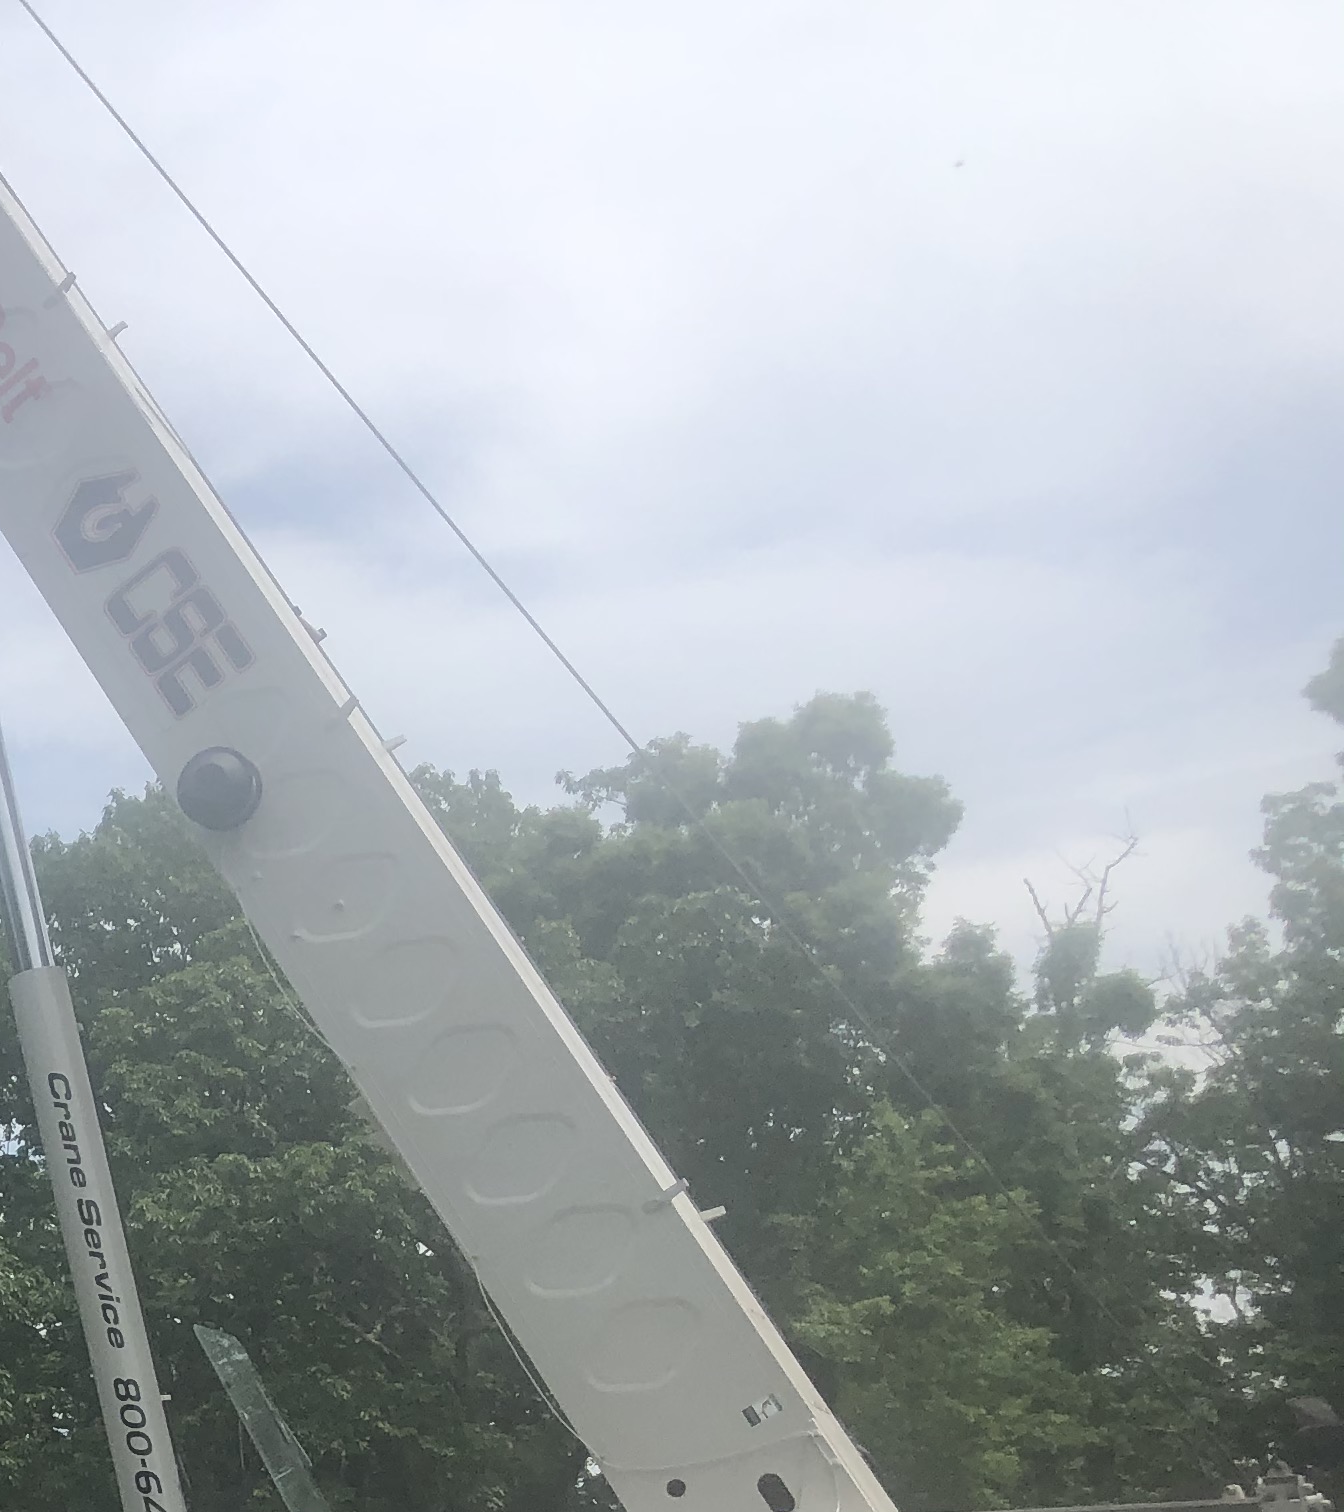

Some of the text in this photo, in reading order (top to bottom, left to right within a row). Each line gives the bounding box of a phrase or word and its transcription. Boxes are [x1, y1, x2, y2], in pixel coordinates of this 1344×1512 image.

[103, 546, 257, 721] CSE
[48, 1072, 87, 1187] Crane
[77, 1199, 125, 1349] Service
